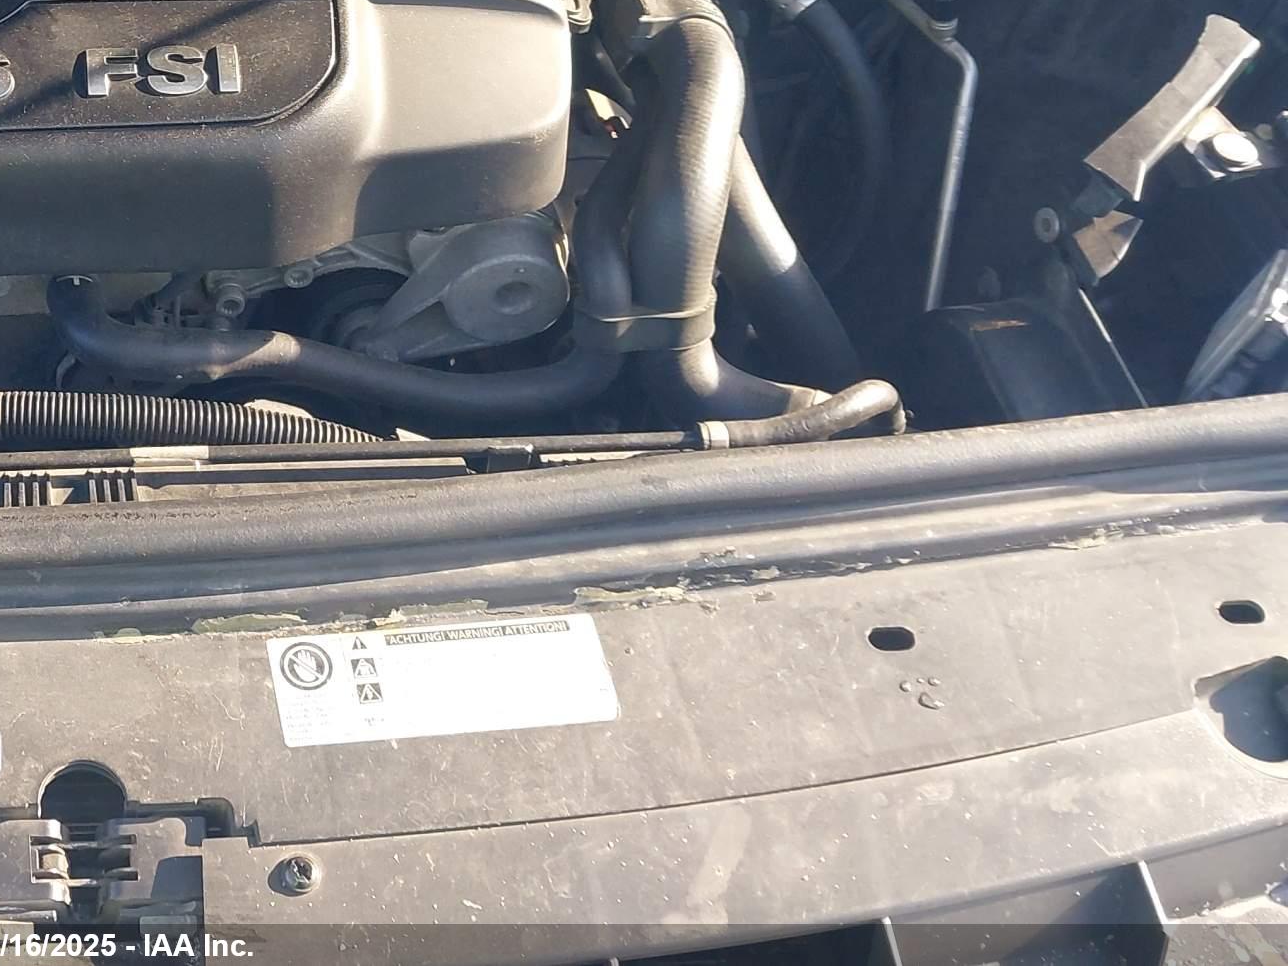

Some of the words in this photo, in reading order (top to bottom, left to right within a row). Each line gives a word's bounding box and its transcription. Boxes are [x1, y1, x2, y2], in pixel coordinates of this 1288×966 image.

[85, 44, 242, 98] FSI
[388, 632, 446, 645] ACHTUNG!
[448, 628, 504, 641] WARNING!
[504, 621, 567, 636] ATTENTION!
